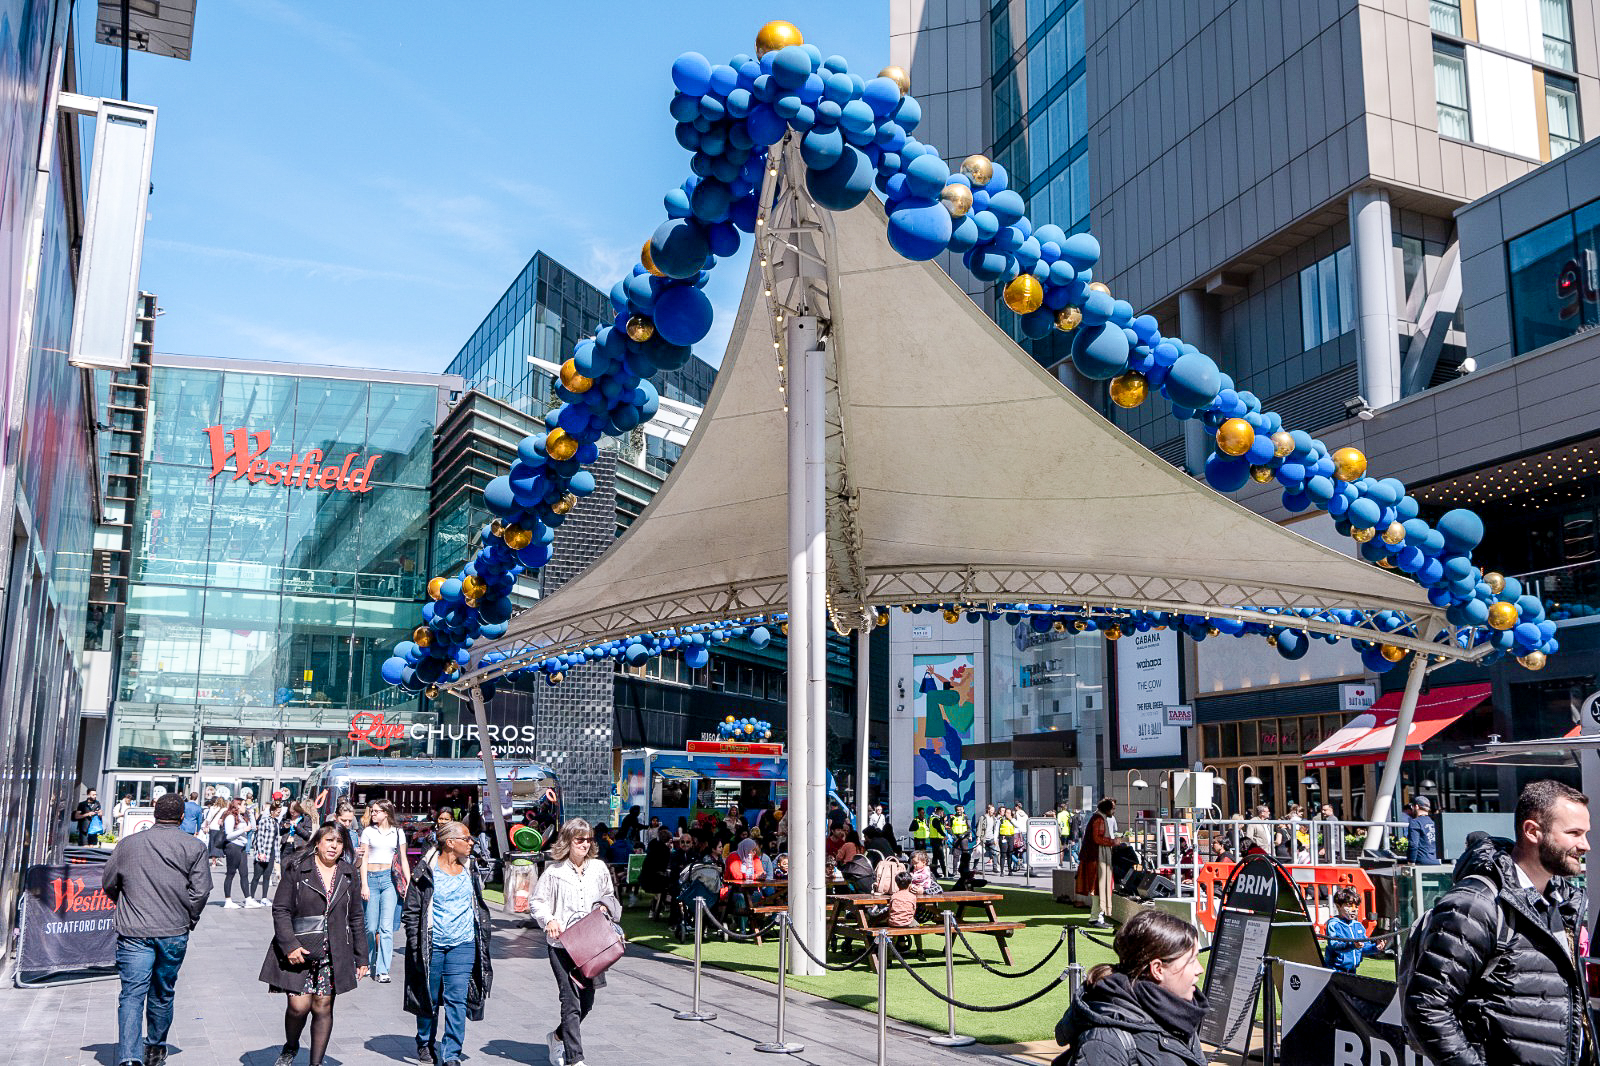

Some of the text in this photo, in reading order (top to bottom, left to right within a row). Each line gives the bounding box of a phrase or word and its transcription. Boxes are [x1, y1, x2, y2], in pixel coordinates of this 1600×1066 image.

[202, 424, 382, 493] Westfield
[1135, 633, 1161, 646] CABANA
[1137, 679, 1162, 690] THE COW
[1168, 710, 1192, 718] TAPAS
[347, 711, 535, 750] Love CHURROS
[490, 745, 534, 754] ONDON
[1236, 873, 1274, 897] BRIM
[50, 877, 116, 912] Westfie
[45, 920, 96, 934] STRATFORD
